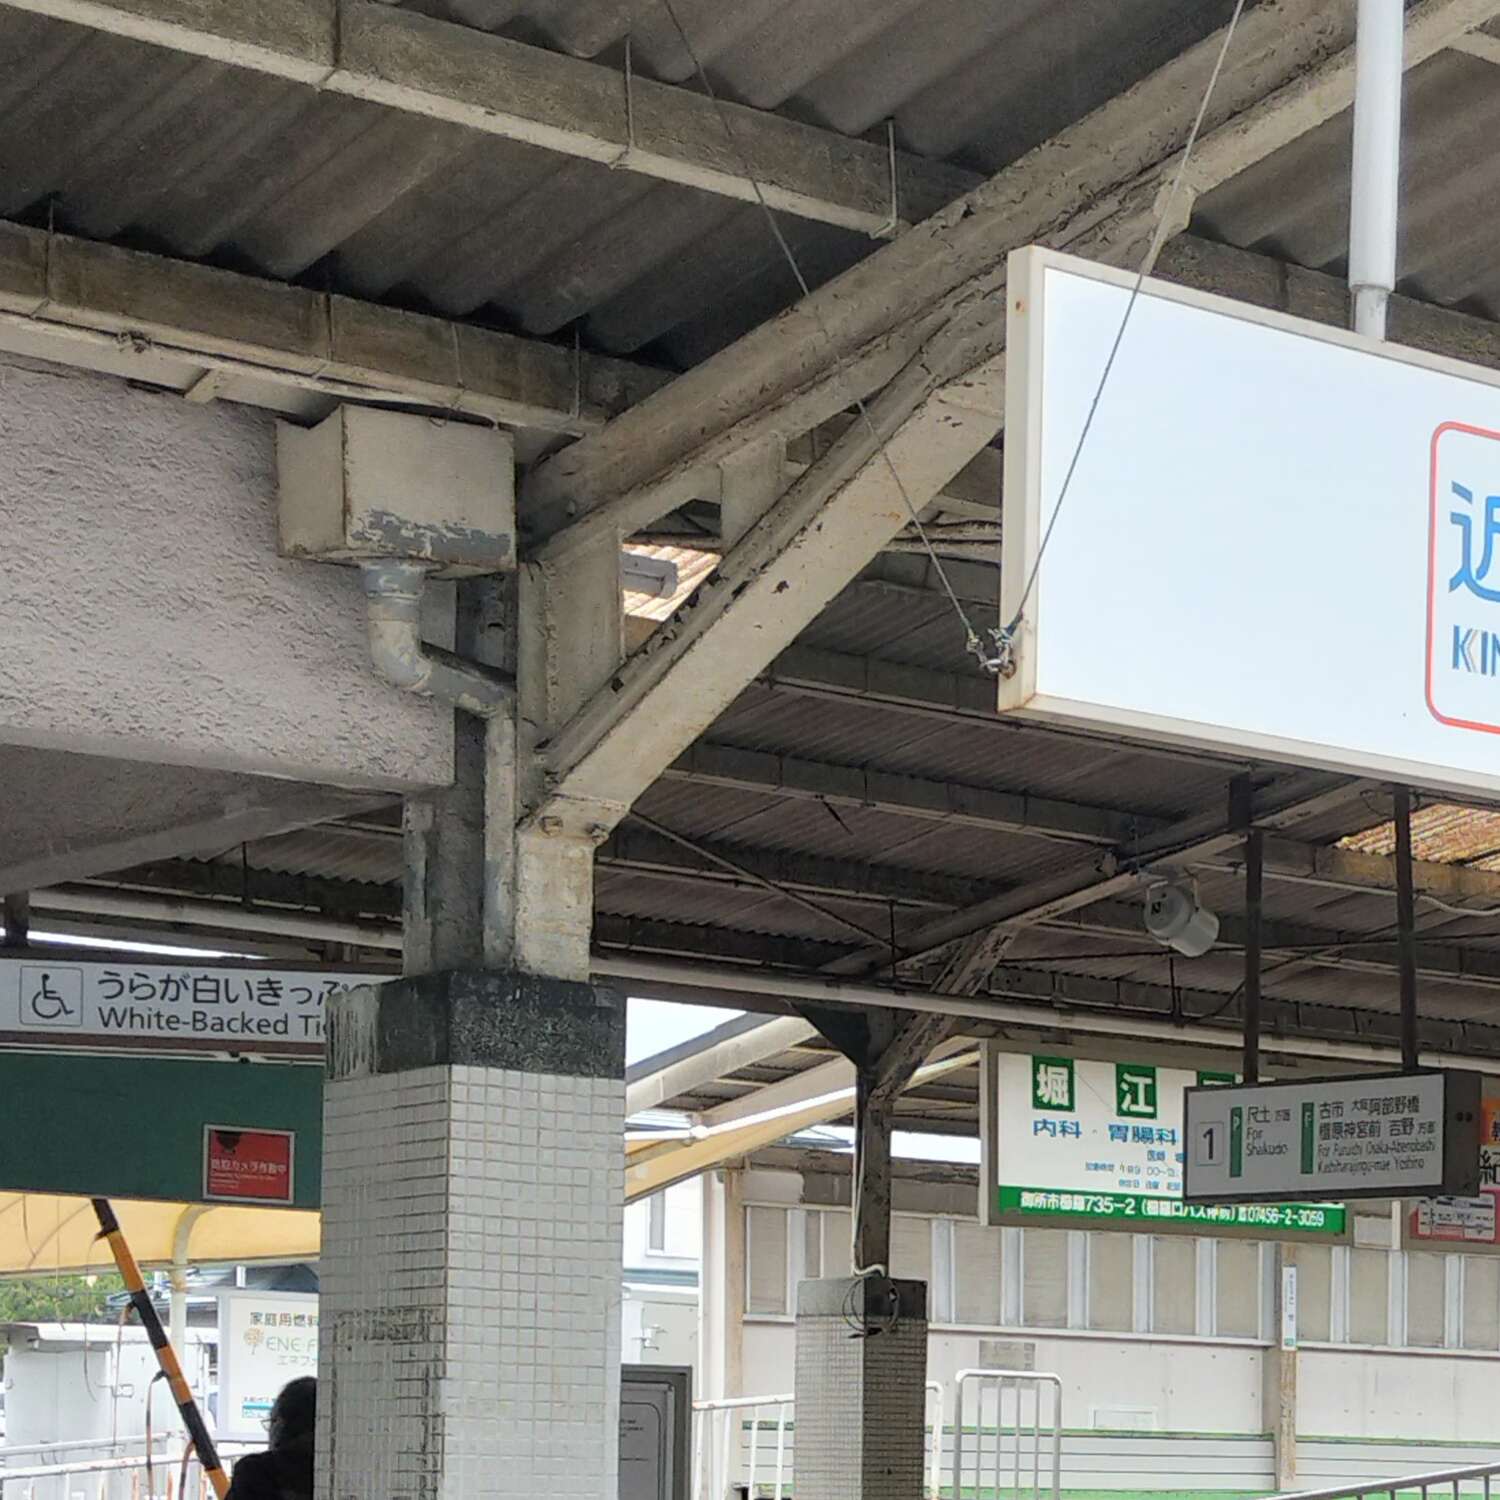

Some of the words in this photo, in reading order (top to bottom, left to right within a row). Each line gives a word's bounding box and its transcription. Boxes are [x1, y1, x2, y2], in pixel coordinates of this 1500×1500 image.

[97, 1006, 289, 1037] White-Backed
[1247, 1106, 1271, 1124] 尺土
[1318, 1101, 1344, 1119] 古市
[1246, 1127, 1264, 1141] For
[1388, 1119, 1415, 1138] 吉野
[1202, 1127, 1214, 1161] 1
